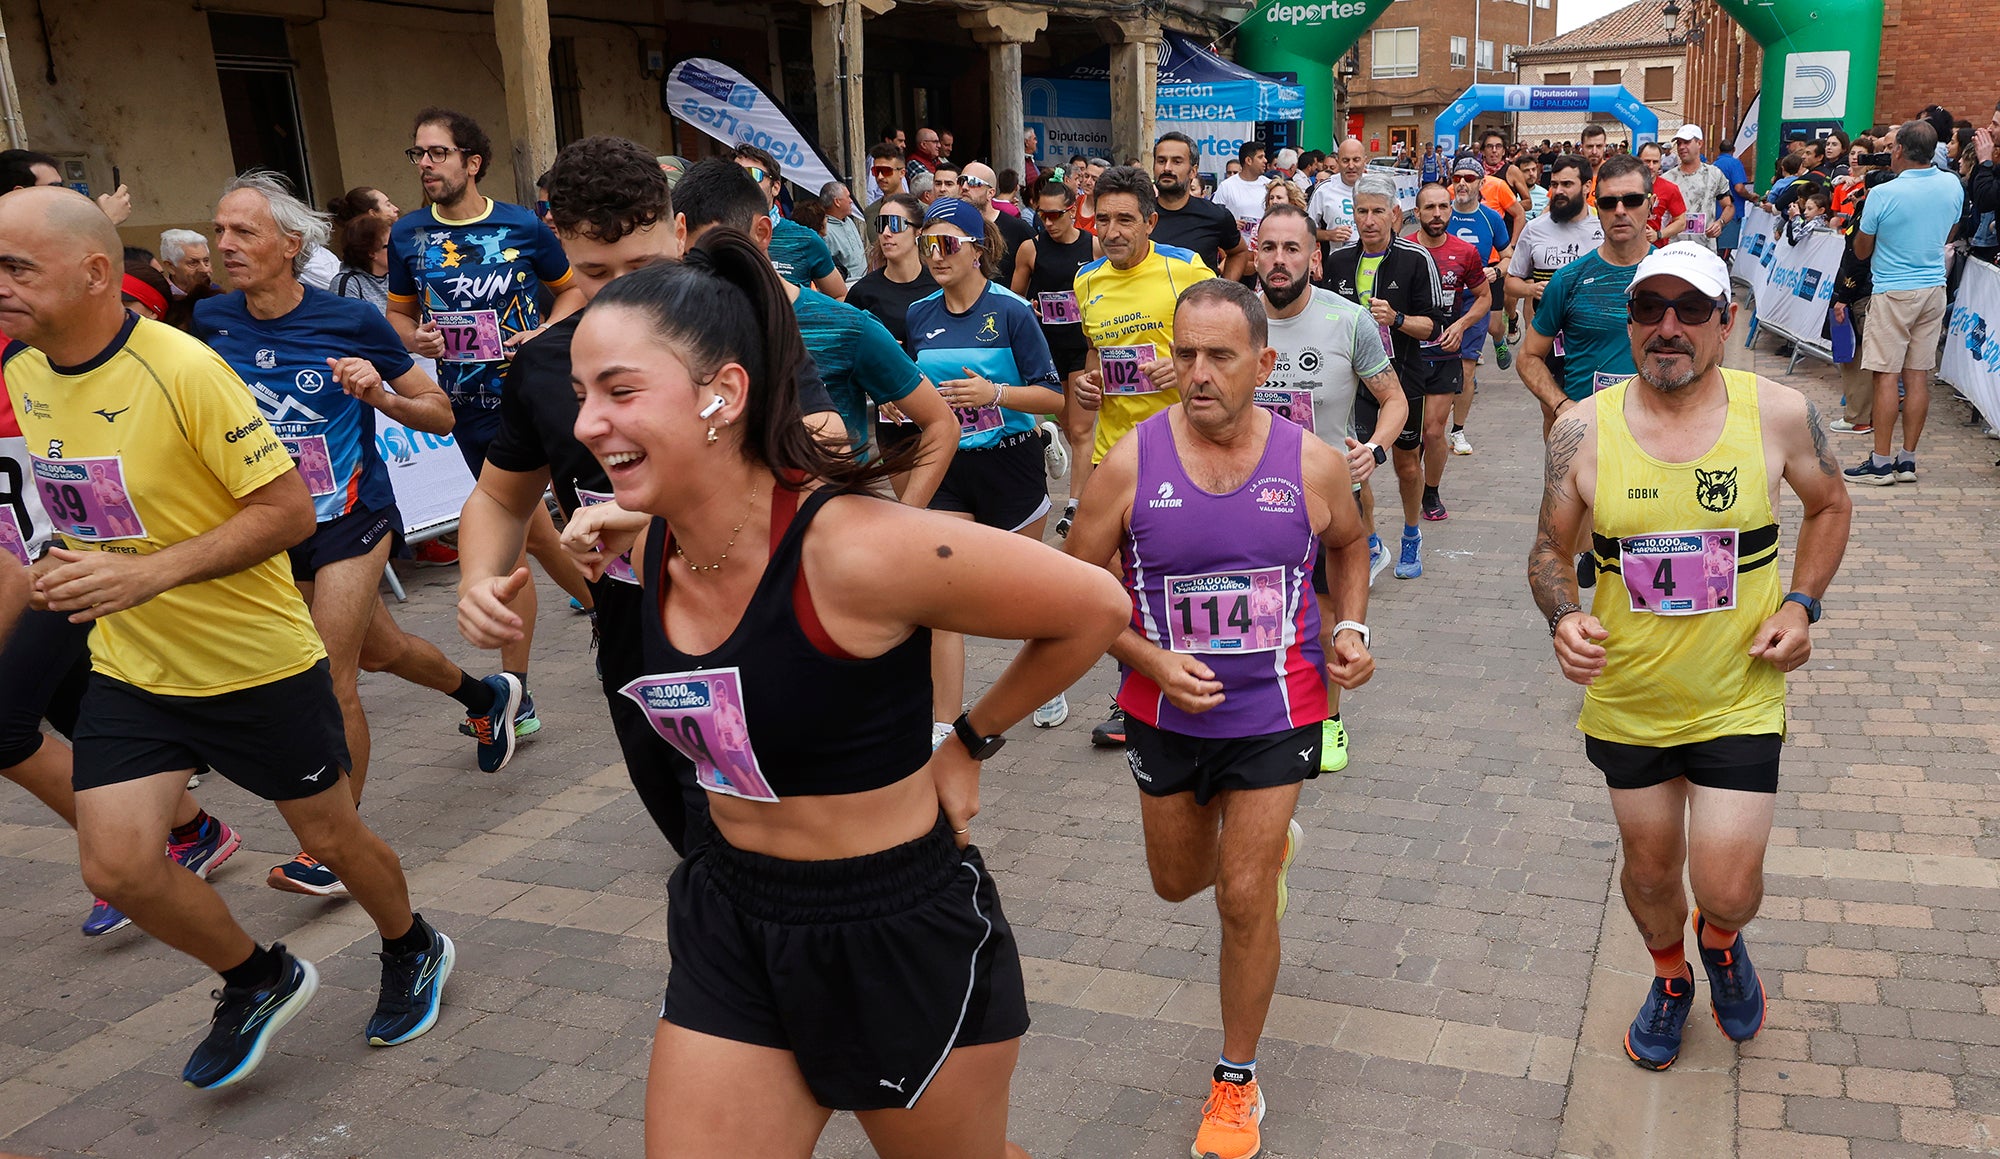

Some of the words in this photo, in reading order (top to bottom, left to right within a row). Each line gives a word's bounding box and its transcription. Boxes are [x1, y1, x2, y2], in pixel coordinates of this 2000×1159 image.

[1267, 1, 1366, 25] deportes
[1533, 89, 1578, 99] Diputación
[1049, 130, 1107, 143] Diputación
[444, 268, 513, 300] RUN
[1048, 302, 1065, 317] 16
[1100, 320, 1111, 328] sin
[1106, 331, 1119, 339] hay
[1121, 321, 1164, 335] VICTORIA
[1104, 361, 1140, 384] 102
[225, 416, 263, 444] Génesis
[1627, 488, 1659, 499] GOBIK
[45, 482, 87, 522] 39
[1149, 499, 1182, 508] VIATOR
[1259, 505, 1294, 513] VALLADOLID
[361, 517, 388, 545] KIPRUN
[1645, 537, 1680, 546] 10.000
[101, 544, 138, 554] Carrera
[1192, 577, 1229, 585] 10.000
[1652, 558, 1676, 597] 4
[1174, 595, 1252, 635] 114
[654, 684, 688, 698] 10.000
